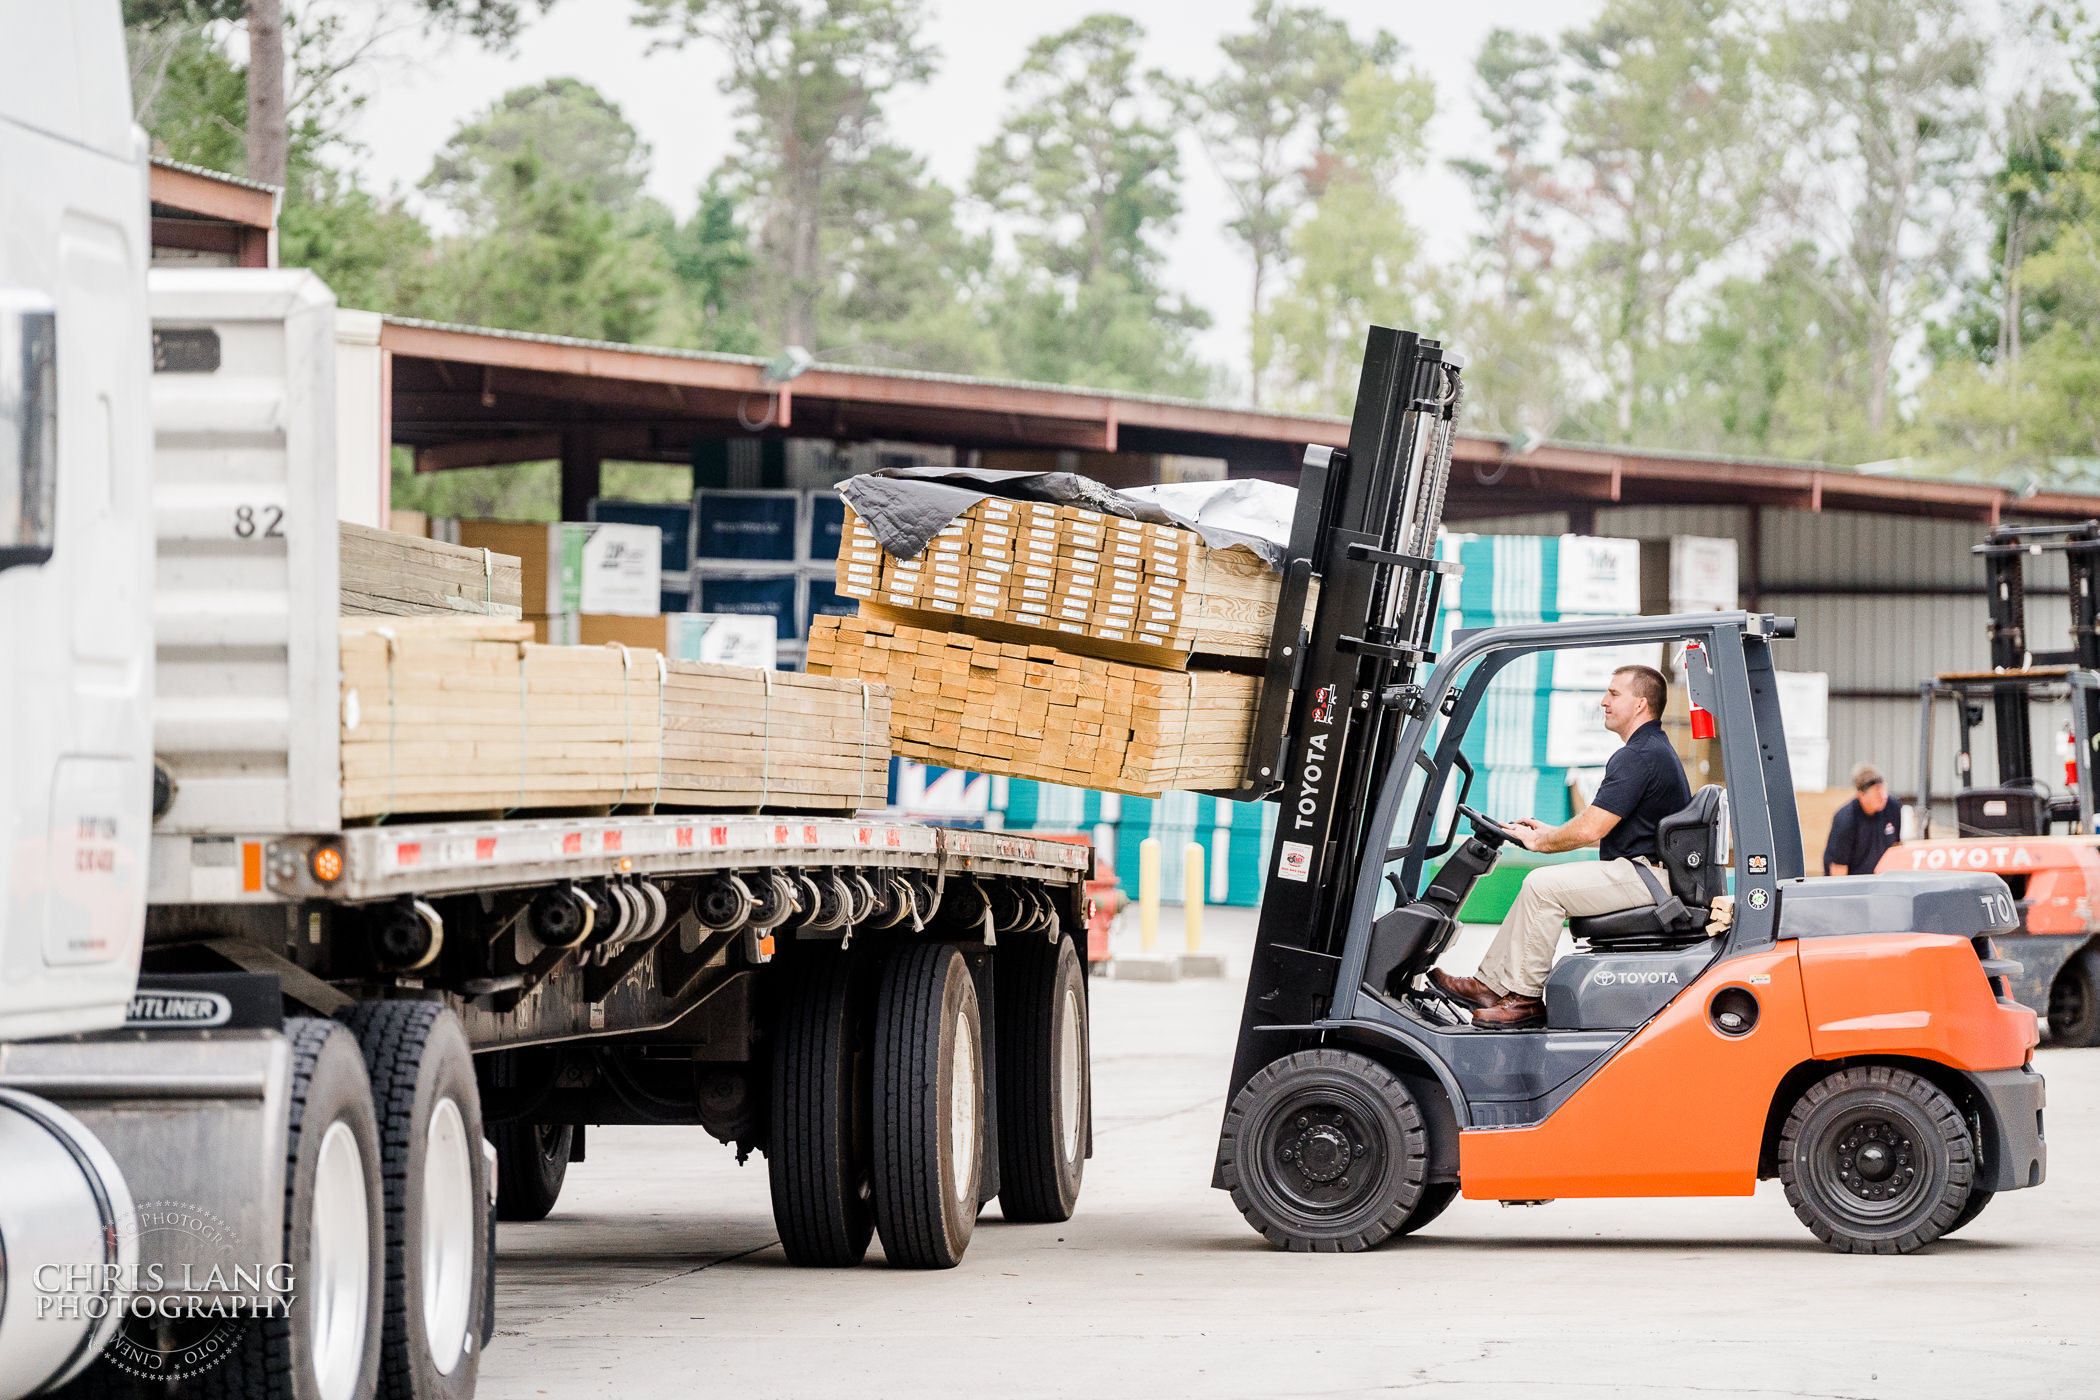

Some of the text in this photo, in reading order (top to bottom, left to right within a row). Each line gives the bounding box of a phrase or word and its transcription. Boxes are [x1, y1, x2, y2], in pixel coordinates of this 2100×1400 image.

[235, 504, 284, 538] 82
[1295, 734, 1329, 830] TOYOTA
[1748, 856, 1767, 868] SAS
[1911, 844, 2033, 870] TOYOTA
[1618, 971, 1679, 984] TOYOTA
